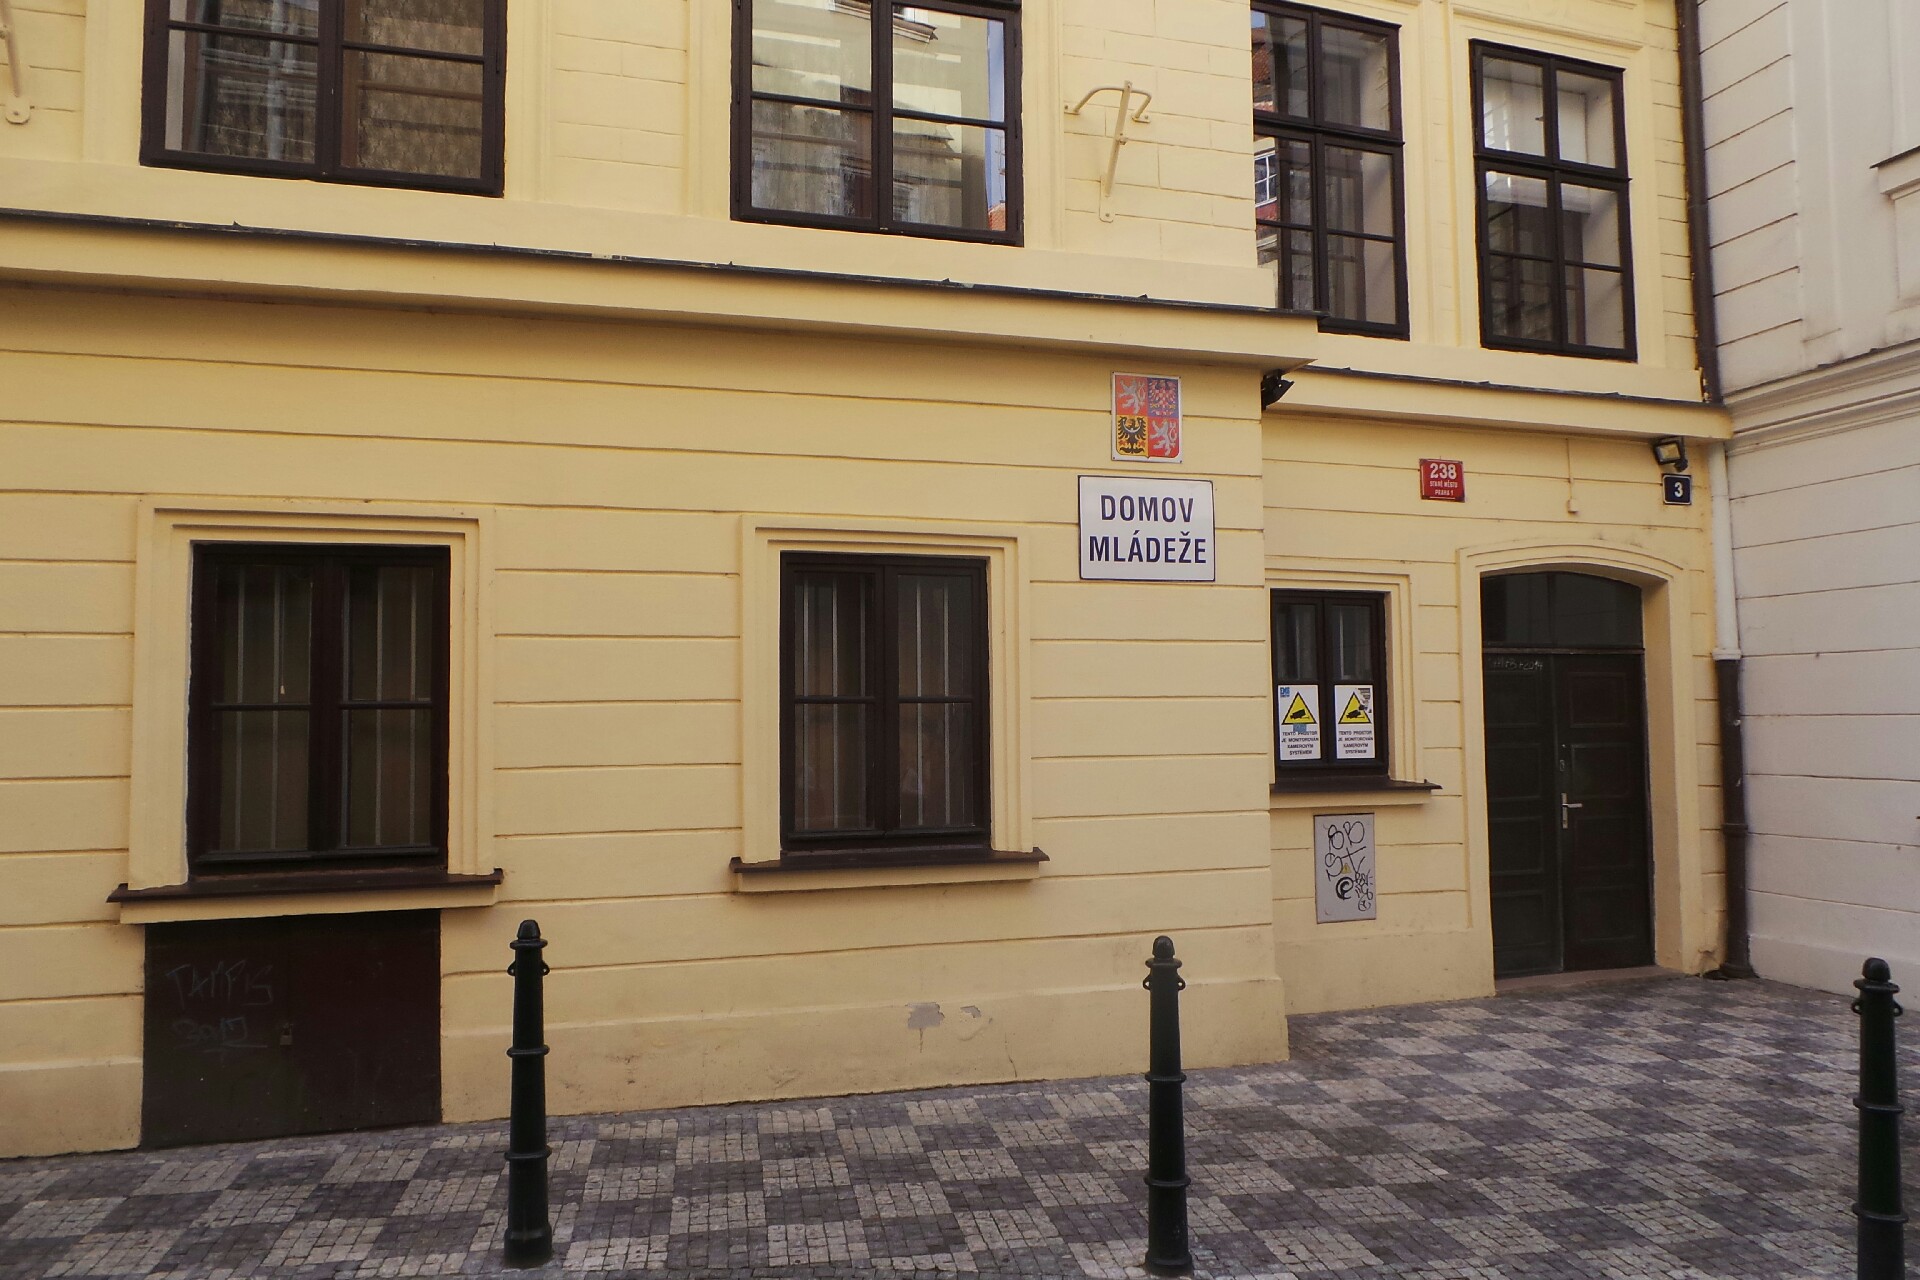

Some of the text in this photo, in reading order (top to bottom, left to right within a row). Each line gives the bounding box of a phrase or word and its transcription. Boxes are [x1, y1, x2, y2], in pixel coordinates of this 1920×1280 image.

[1430, 463, 1457, 479] 238
[1674, 481, 1683, 497] 3
[1100, 494, 1194, 523] DOMOV
[1089, 529, 1206, 564] MLÁDEŽE
